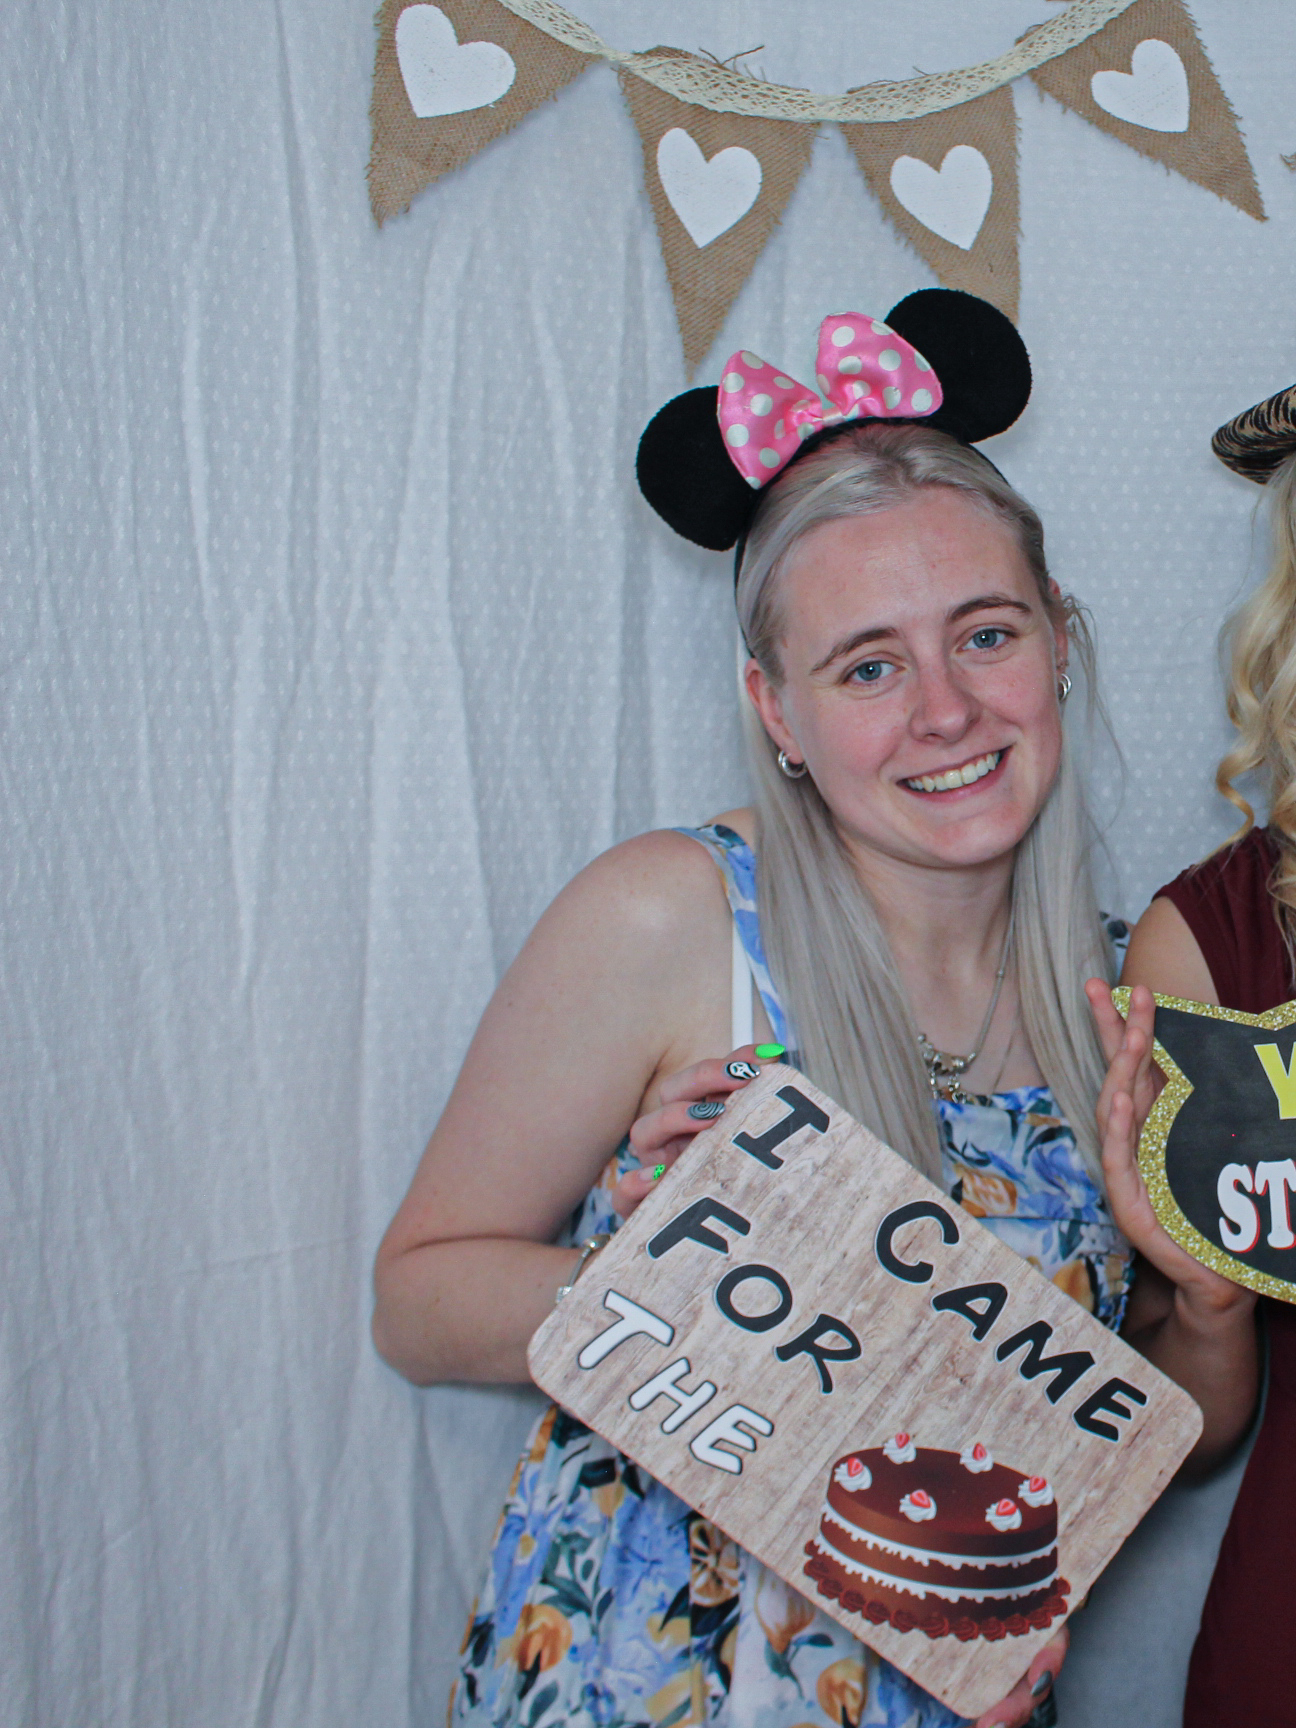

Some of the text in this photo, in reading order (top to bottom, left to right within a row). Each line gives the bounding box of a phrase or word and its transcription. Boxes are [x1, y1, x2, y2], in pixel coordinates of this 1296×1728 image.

[646, 1196, 862, 1393] FOR
[731, 1085, 1148, 1442] I CAME
[577, 1288, 775, 1475] THE
